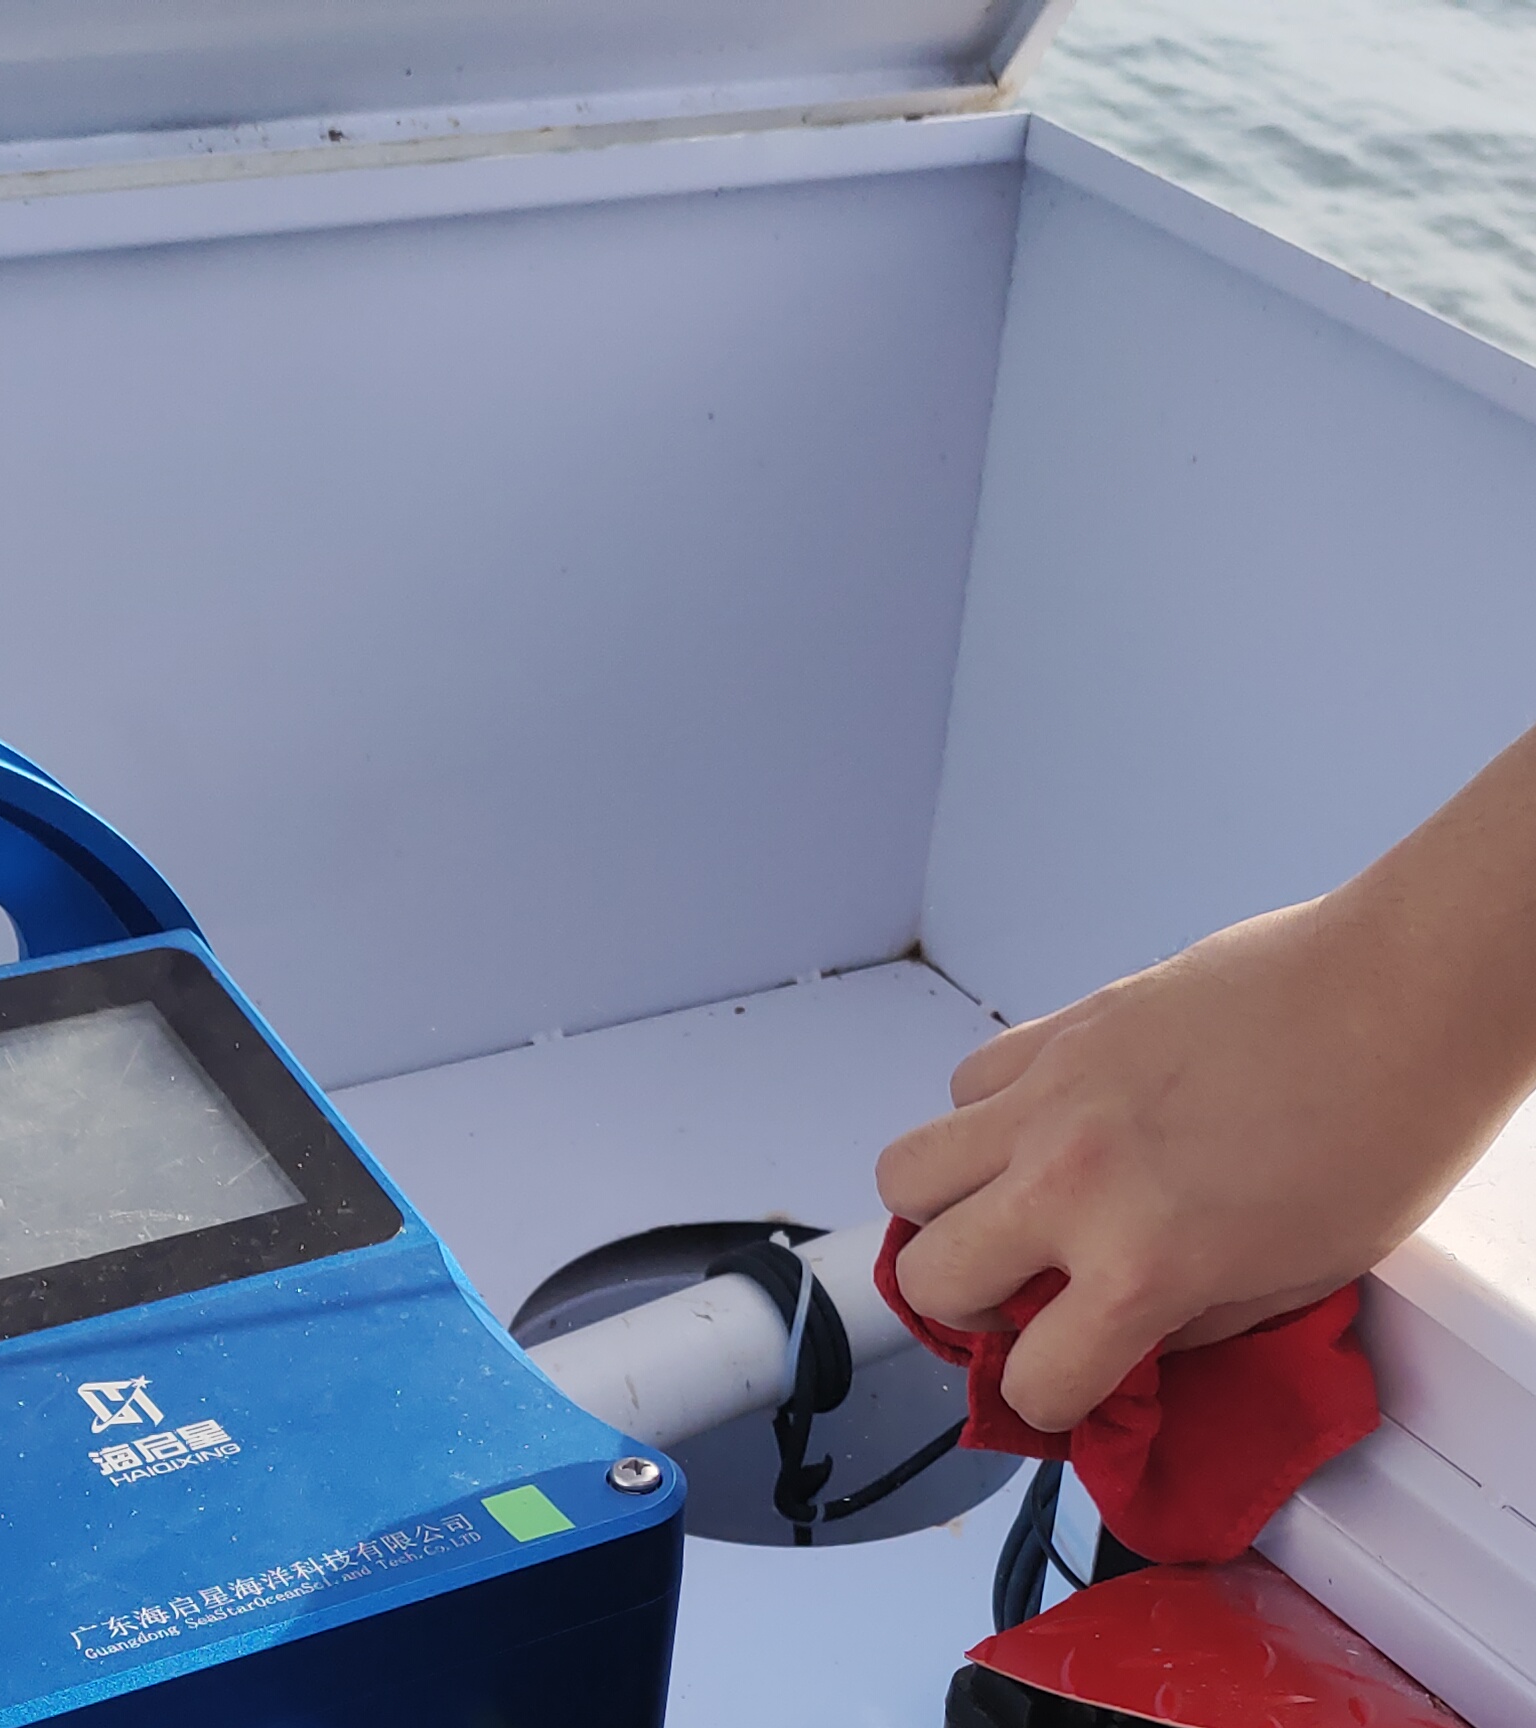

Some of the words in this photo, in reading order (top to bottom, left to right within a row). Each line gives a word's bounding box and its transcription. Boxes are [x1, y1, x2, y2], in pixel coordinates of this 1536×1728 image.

[88, 1419, 232, 1476] 海启星
[109, 1443, 241, 1487] HAIQIXING
[69, 1513, 474, 1650] 广东海启星海洋科技有限公司
[85, 1624, 181, 1660] Guangdong
[342, 1566, 372, 1583] and
